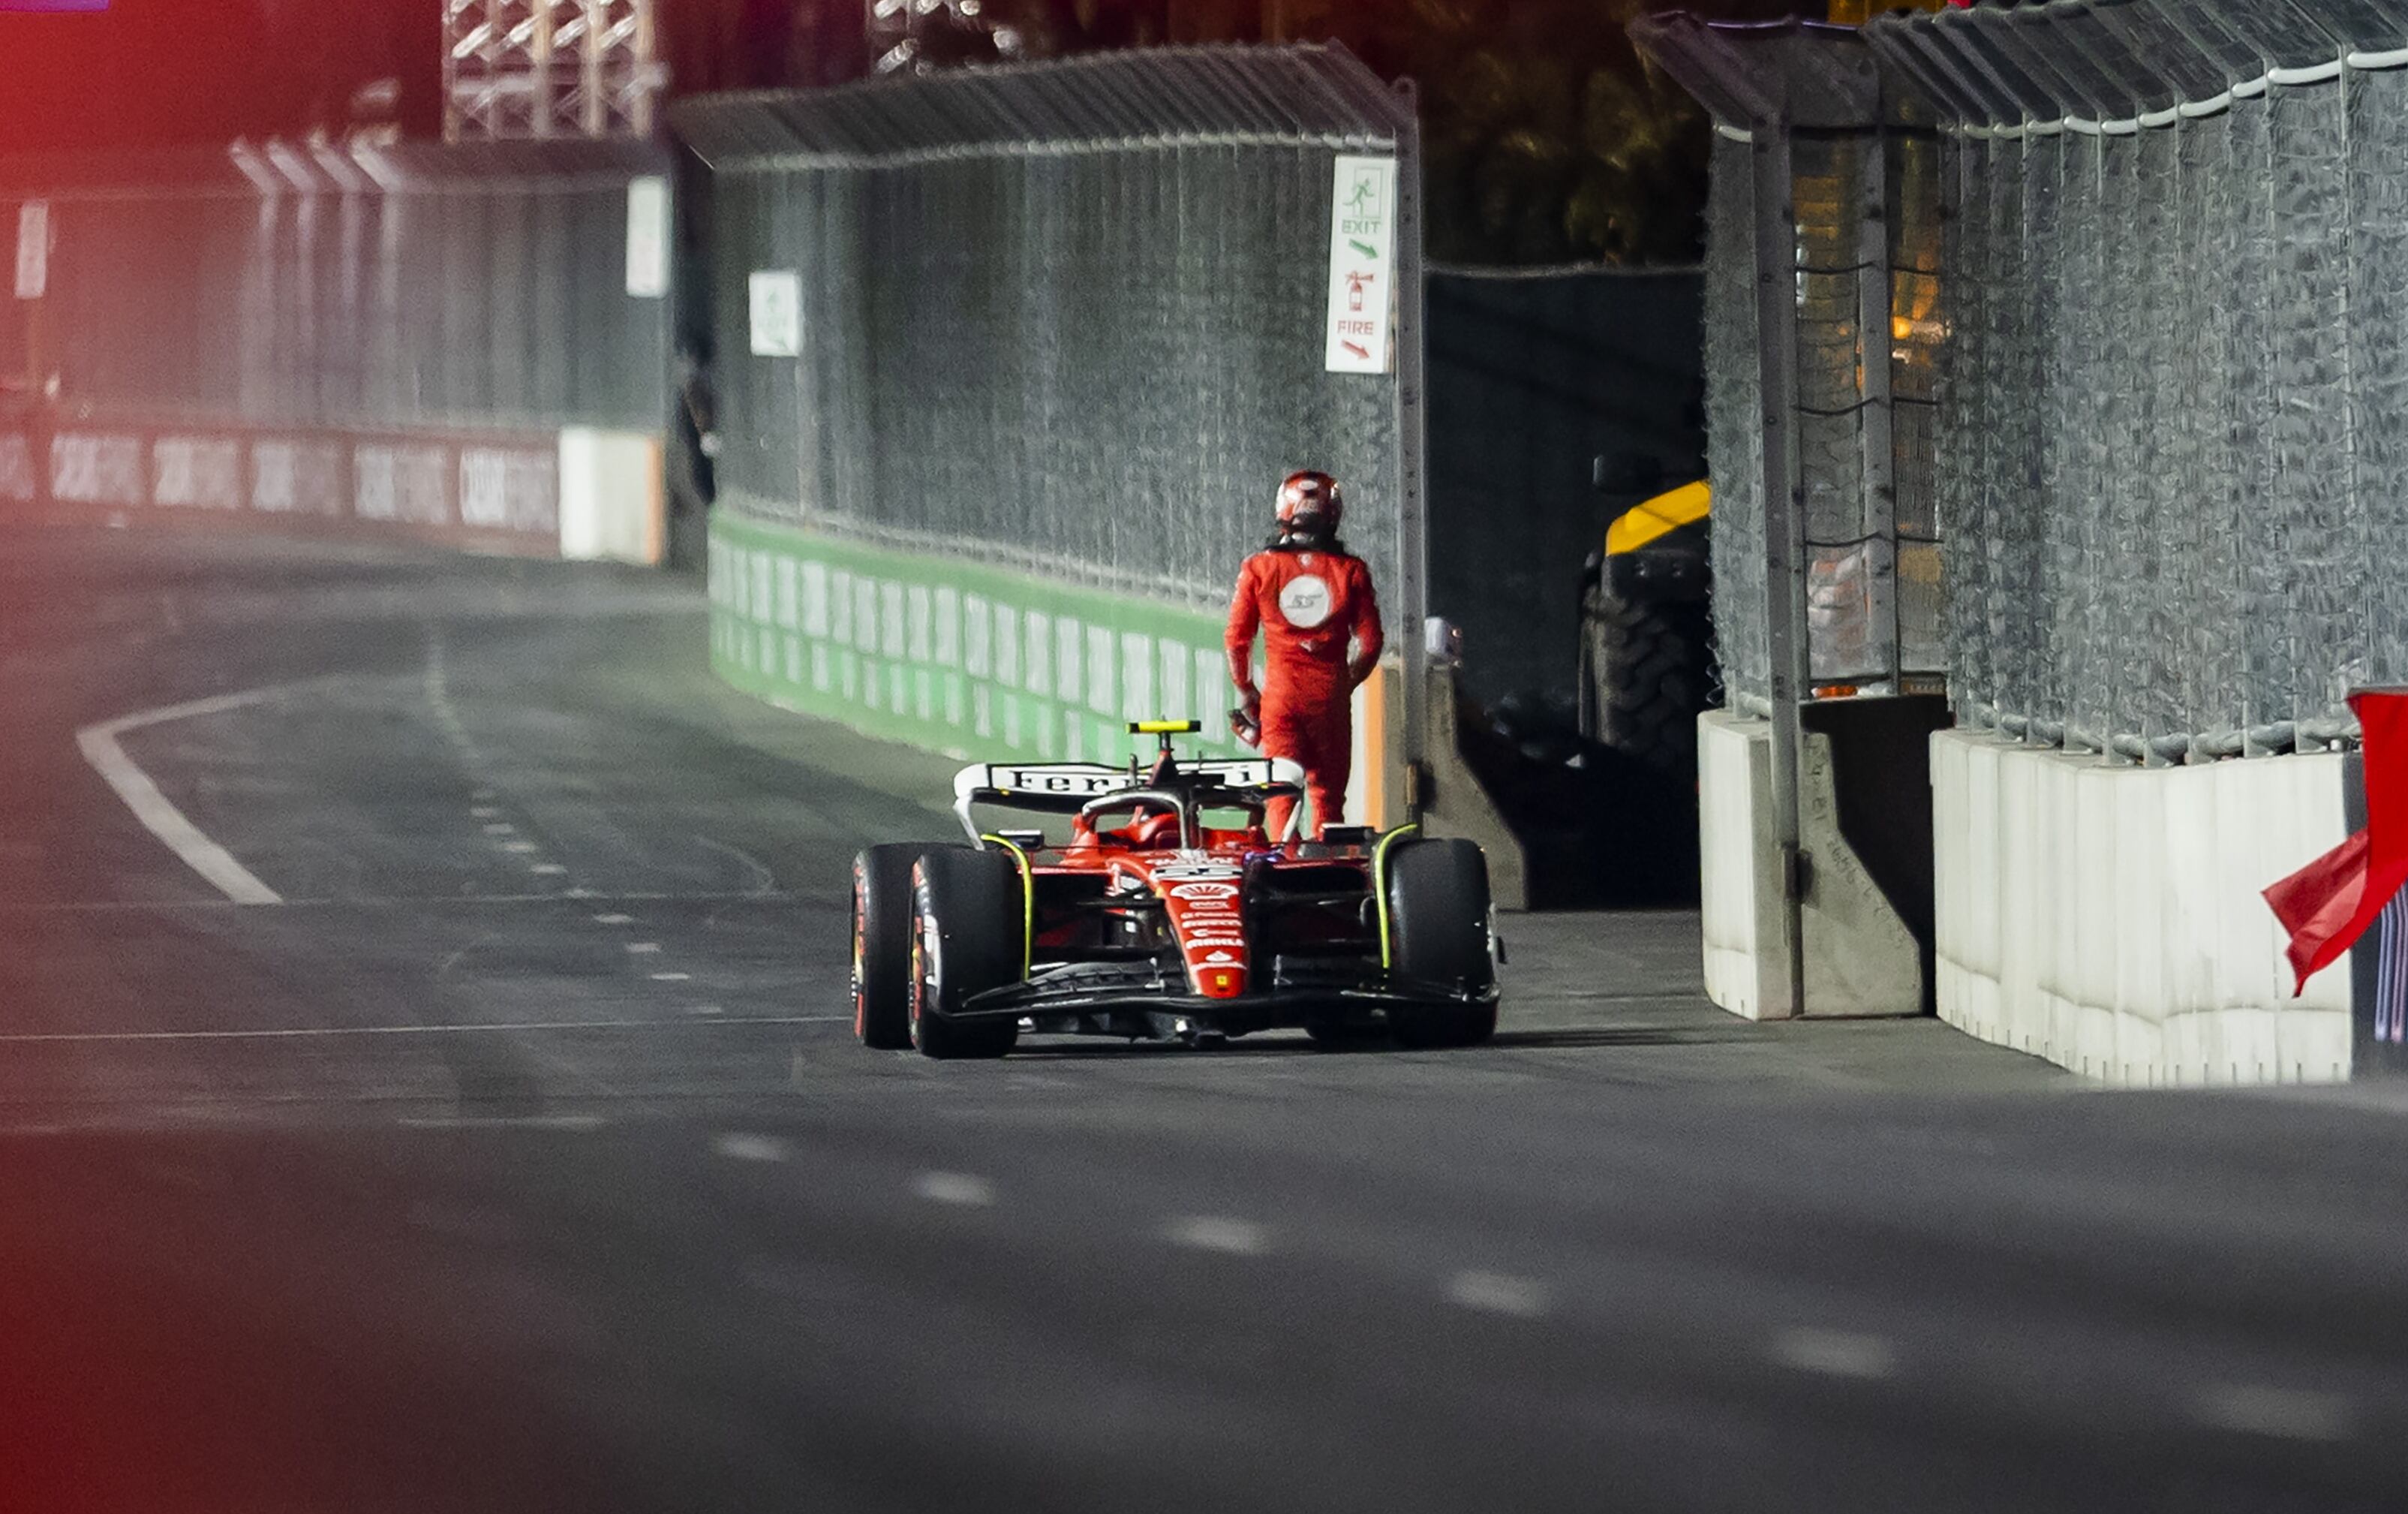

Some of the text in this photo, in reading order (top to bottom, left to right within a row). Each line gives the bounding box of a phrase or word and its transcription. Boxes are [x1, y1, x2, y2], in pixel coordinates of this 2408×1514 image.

[1342, 220, 1381, 234] EXIT
[1337, 321, 1374, 336] FIRE
[1008, 764, 1252, 792] Feri
